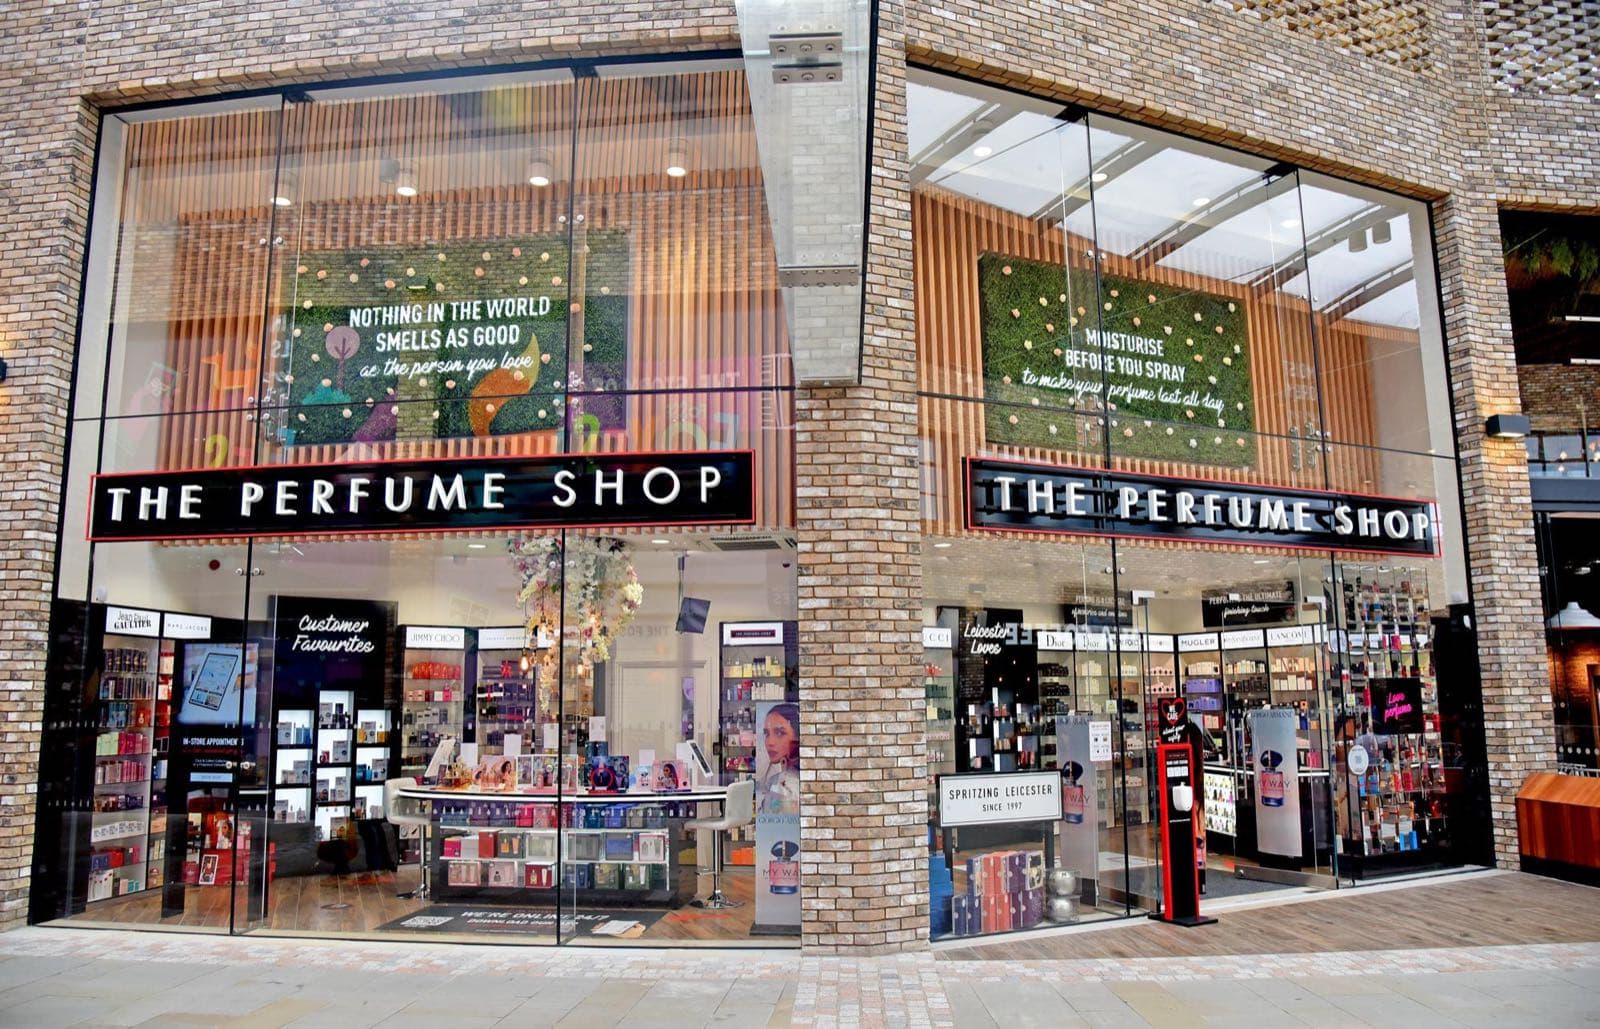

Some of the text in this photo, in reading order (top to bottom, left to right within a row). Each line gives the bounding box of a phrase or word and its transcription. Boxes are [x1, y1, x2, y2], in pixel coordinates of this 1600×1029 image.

[350, 296, 551, 327] NOTHING IN THE WORLD
[376, 324, 520, 352] SMELLS AS GOOD
[1085, 327, 1165, 357] MOISTURISE
[384, 358, 409, 375] the
[409, 359, 464, 380] person
[466, 358, 496, 381] you
[500, 351, 533, 369] love
[1065, 350, 1186, 383] BEFORE YOU SPRAY
[1022, 367, 1225, 417] to make your perfume last all day
[107, 466, 721, 521] THE PERFUME SHOP
[994, 477, 1430, 540] THE PERFUME SHOP
[1243, 593, 1254, 601] THE
[1255, 590, 1282, 600] ULTIMATE
[1224, 605, 1250, 619] finishing
[299, 614, 369, 633] Customer
[964, 621, 1010, 639] Leicester
[292, 634, 375, 653] Favourites
[411, 633, 461, 643] JIMMY CHOO
[970, 639, 1002, 655] Loves
[1046, 634, 1066, 648] Dior
[1083, 635, 1100, 649] Dior
[1181, 638, 1215, 647] MUGLER
[183, 738, 206, 746] IN-STORE
[949, 784, 1053, 800] SPRITZING LEICESTER
[982, 801, 1023, 812] SINCE 1997
